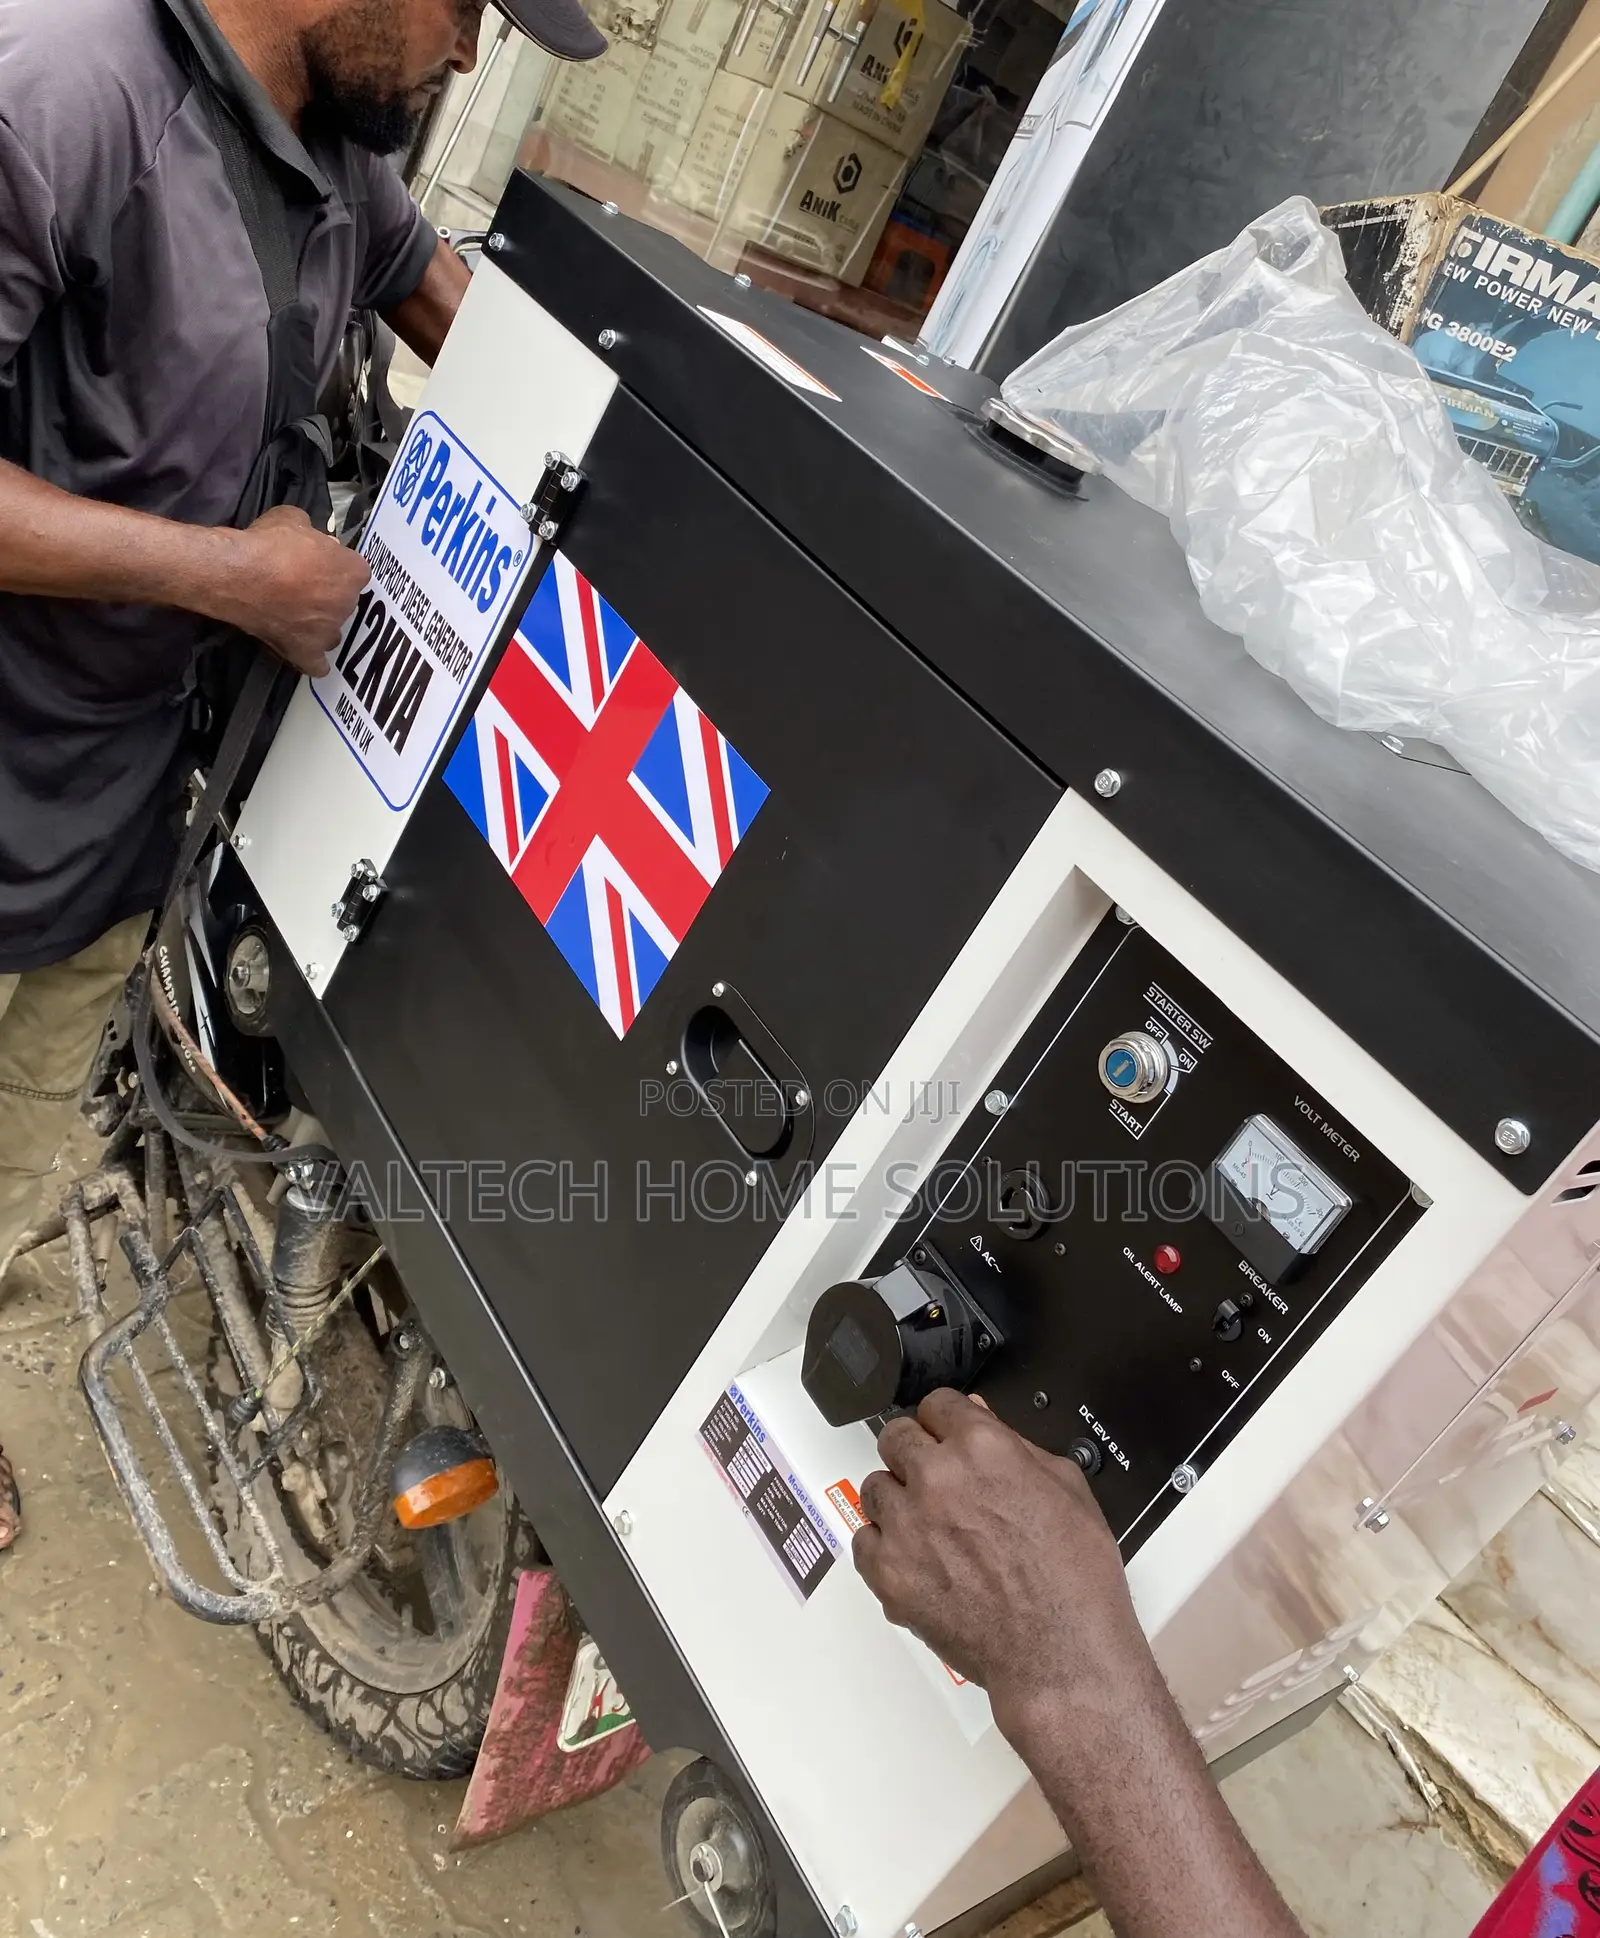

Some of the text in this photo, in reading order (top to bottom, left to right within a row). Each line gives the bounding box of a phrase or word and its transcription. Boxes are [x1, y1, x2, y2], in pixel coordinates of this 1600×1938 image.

[1443, 261, 1593, 334] EW POWER NEW
[1416, 307, 1518, 363] PG 3800E2
[406, 440, 512, 614] Perkins
[364, 531, 474, 685] SOUNDPROOF DIESEL GENERATOR
[335, 589, 434, 757] 12KVA
[334, 692, 375, 756] MADE IN UK
[159, 945, 181, 1022] CHAMPI
[1145, 1020, 1165, 1039] OFF
[1146, 986, 1212, 1049] STARTER SW
[1178, 1053, 1194, 1069] ON
[1109, 1099, 1143, 1133] START
[1293, 1094, 1361, 1163] VOLT METER
[1122, 1246, 1183, 1314] OIL ALERT LAMP
[1238, 1260, 1289, 1315] BREAKER
[1257, 1327, 1272, 1344] ON
[1221, 1369, 1240, 1390] OFF
[734, 1392, 768, 1444] Perkins
[1078, 1404, 1131, 1472] DC 12V 8.3A
[841, 1499, 851, 1510] NOT
[849, 1510, 859, 1522] RUN
[841, 1508, 852, 1523] AUTO
